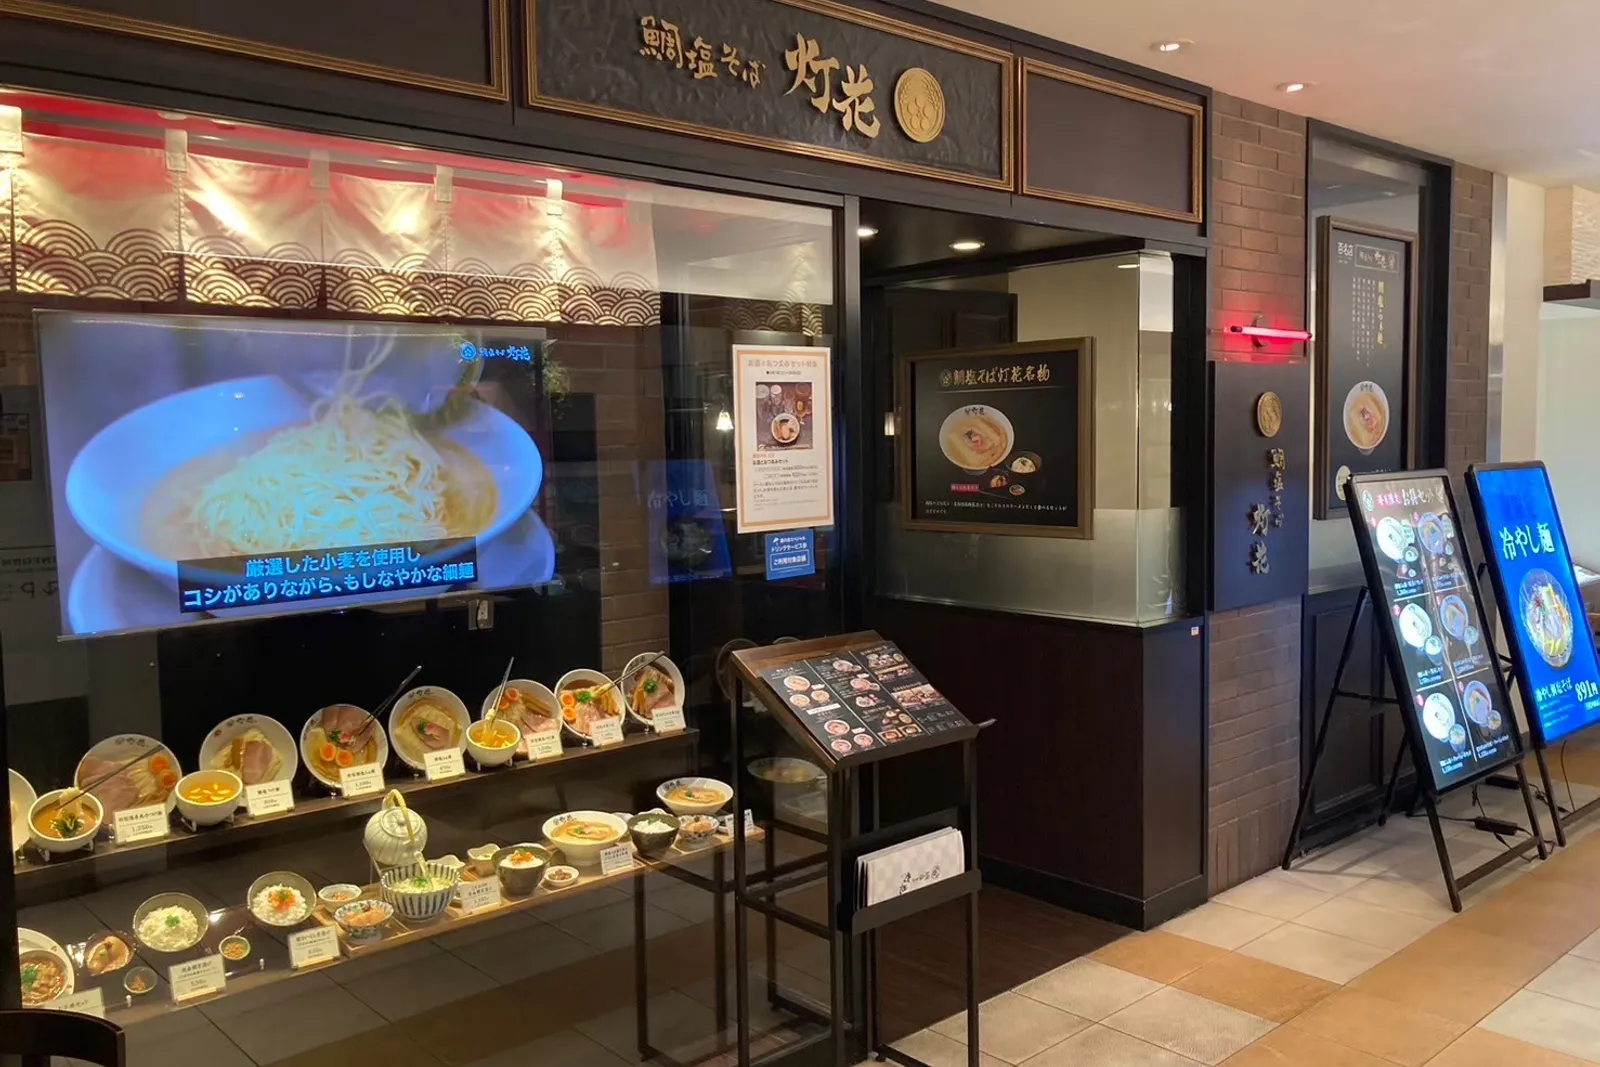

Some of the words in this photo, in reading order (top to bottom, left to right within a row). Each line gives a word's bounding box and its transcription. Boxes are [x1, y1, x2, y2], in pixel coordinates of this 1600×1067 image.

[639, 16, 766, 89] 鯛塩そば
[783, 33, 880, 138] 灯花
[506, 345, 531, 361] 灯花
[953, 363, 1050, 386] 鯛塩そば灯花名物
[1270, 448, 1285, 528] 鯛塩そば
[1252, 503, 1271, 574] 灯花
[1498, 522, 1555, 560] 冷やし麺
[245, 547, 421, 578] 厳選した小麦を使用し
[184, 562, 475, 607] コシがありながら、もしなやかな細麺
[1574, 679, 1599, 702] 891円
